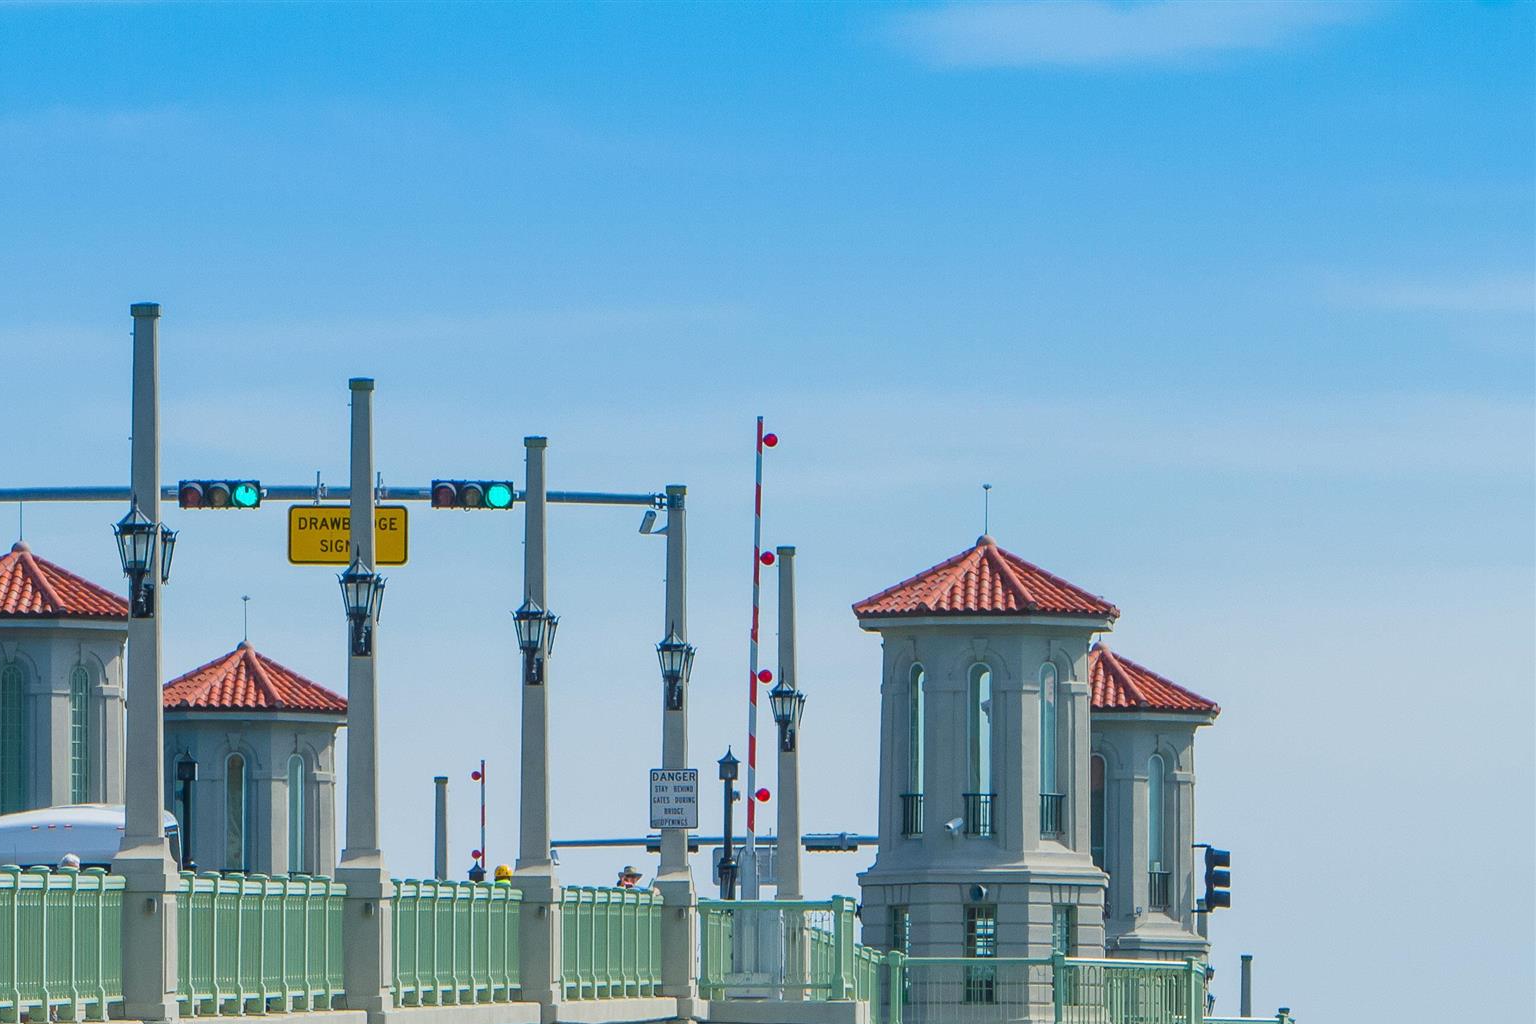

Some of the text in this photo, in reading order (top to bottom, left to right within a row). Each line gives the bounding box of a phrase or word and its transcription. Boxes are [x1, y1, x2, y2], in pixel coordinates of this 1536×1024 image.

[298, 517, 398, 530] DRAWBGE
[652, 772, 696, 781] DANGER
[655, 785, 693, 793] STAY BEHIND
[653, 796, 695, 804] GATES DURING
[664, 807, 684, 815] BRIDGE
